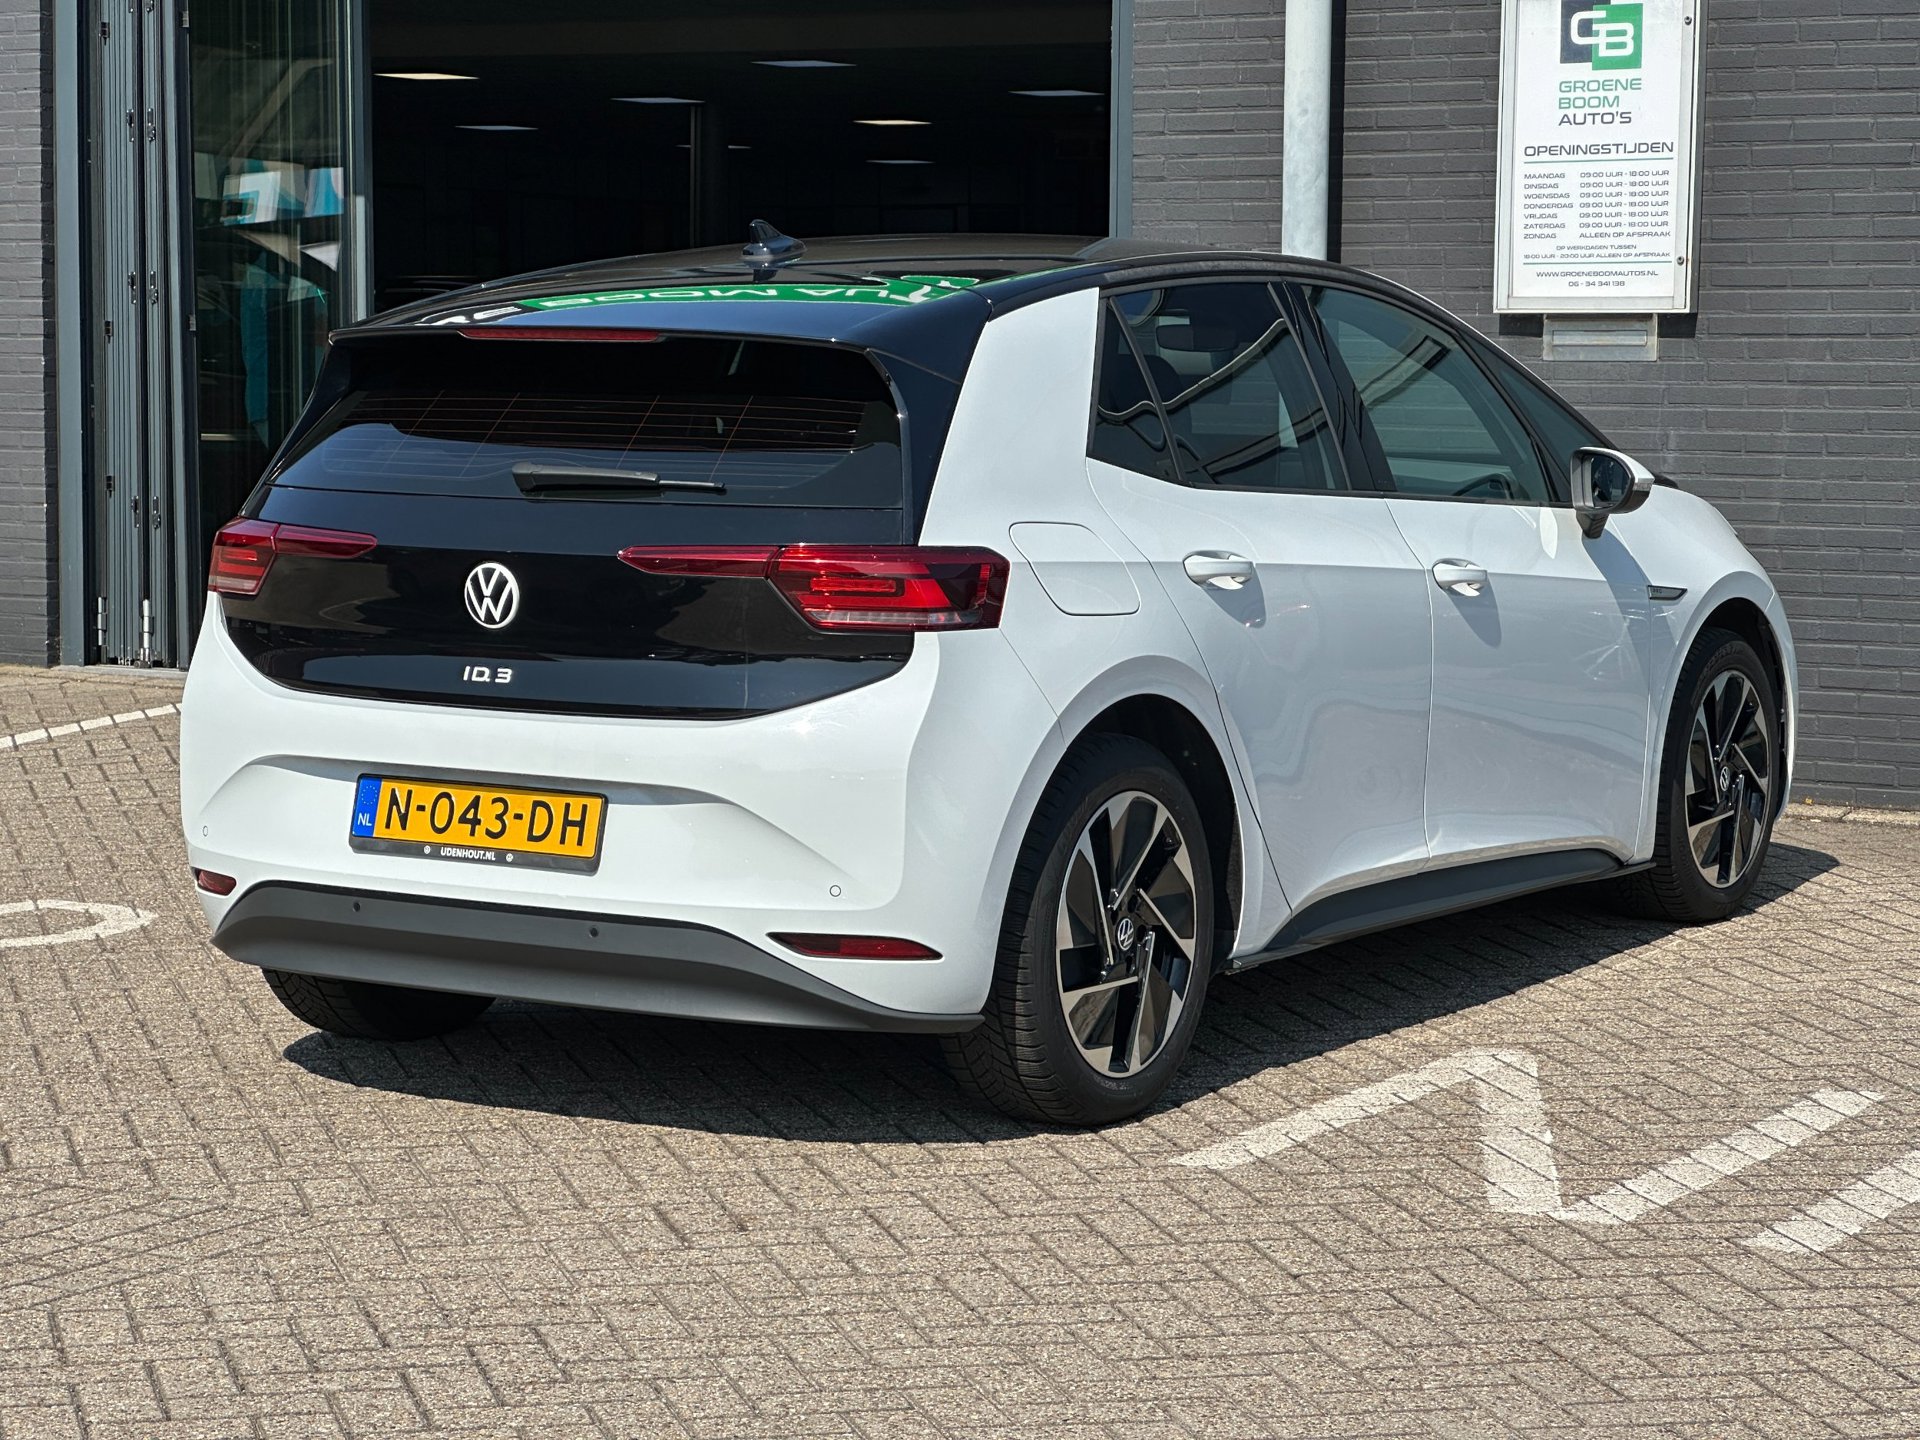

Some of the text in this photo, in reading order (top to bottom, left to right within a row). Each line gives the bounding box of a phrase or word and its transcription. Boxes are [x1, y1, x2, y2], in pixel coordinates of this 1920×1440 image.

[1559, 78, 1642, 93] GROENE
[1558, 95, 1620, 109] BOOM
[1558, 111, 1632, 126] AUTO'S
[1524, 141, 1674, 157] OPENINGSTIJDEN
[357, 812, 372, 827] NL
[384, 787, 588, 847] N-043-DH
[440, 846, 496, 861] UDENHOUT.NL
